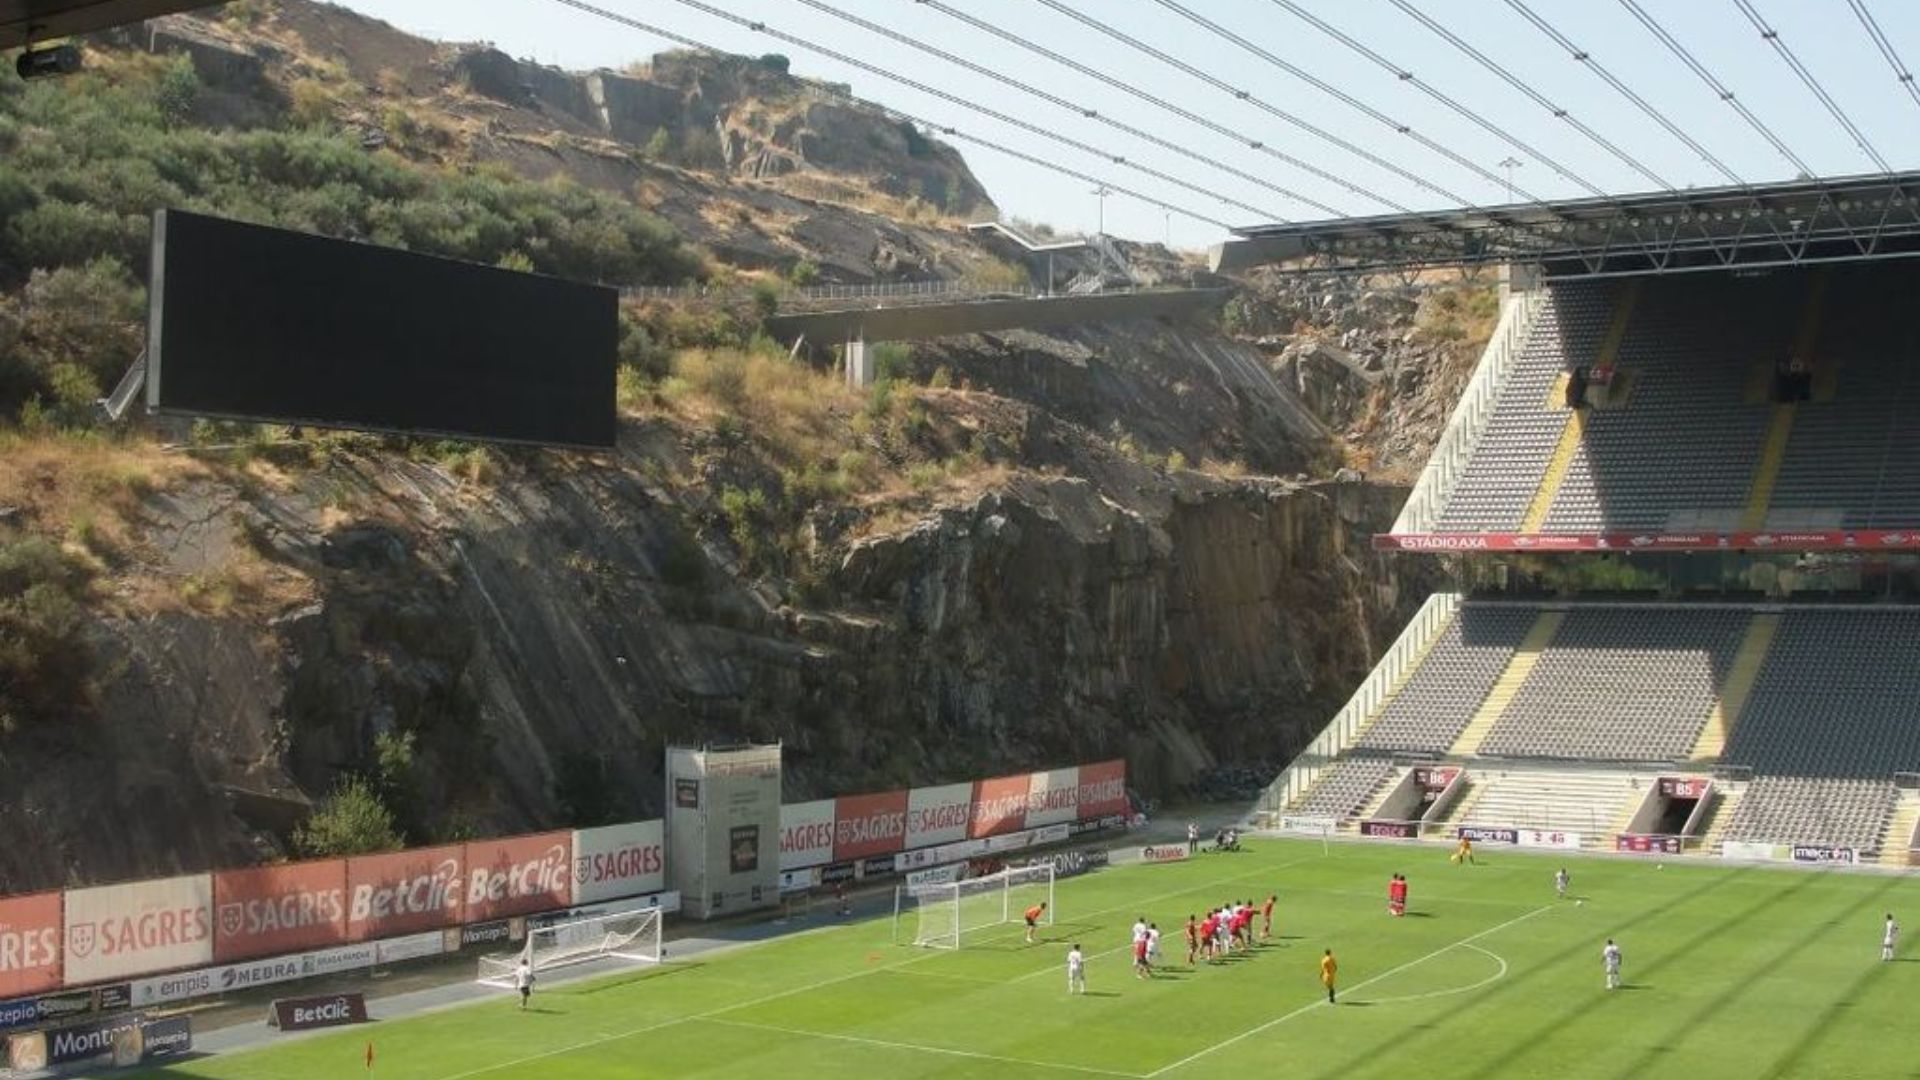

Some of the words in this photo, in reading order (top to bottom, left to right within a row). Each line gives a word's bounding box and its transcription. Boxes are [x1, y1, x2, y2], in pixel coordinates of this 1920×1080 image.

[1459, 537, 1488, 548] AXA
[851, 812, 904, 843] SAGRES
[920, 803, 970, 832] SAGRES
[467, 845, 568, 905] BetClic
[593, 845, 661, 883] SAGRES
[350, 859, 462, 921] BetClic
[246, 889, 343, 935] SAGRES
[100, 906, 209, 956] SAGRES
[160, 974, 210, 999] empis
[238, 962, 297, 983] MEBRA
[294, 998, 350, 1023] BetClic
